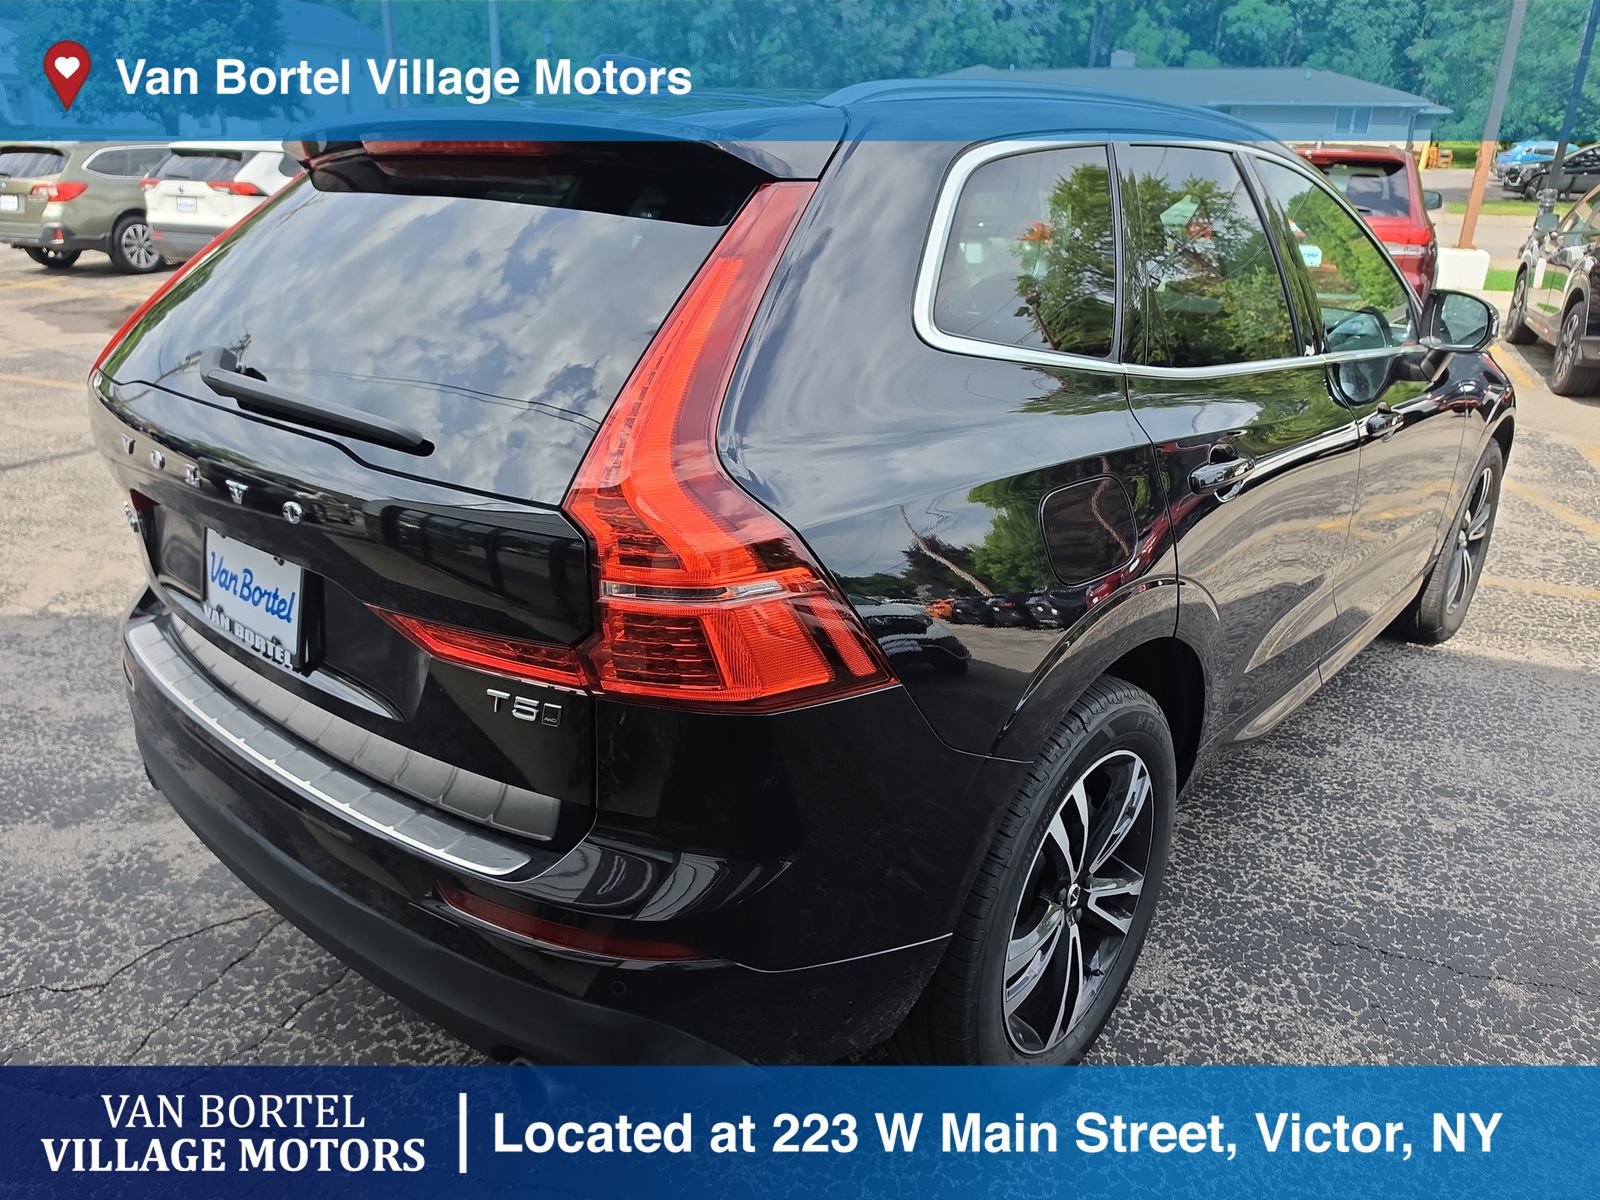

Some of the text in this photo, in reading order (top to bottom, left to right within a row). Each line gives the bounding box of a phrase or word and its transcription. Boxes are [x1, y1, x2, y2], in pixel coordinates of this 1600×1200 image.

[202, 603, 293, 670] VAN BORTEL
[486, 688, 540, 722] T5
